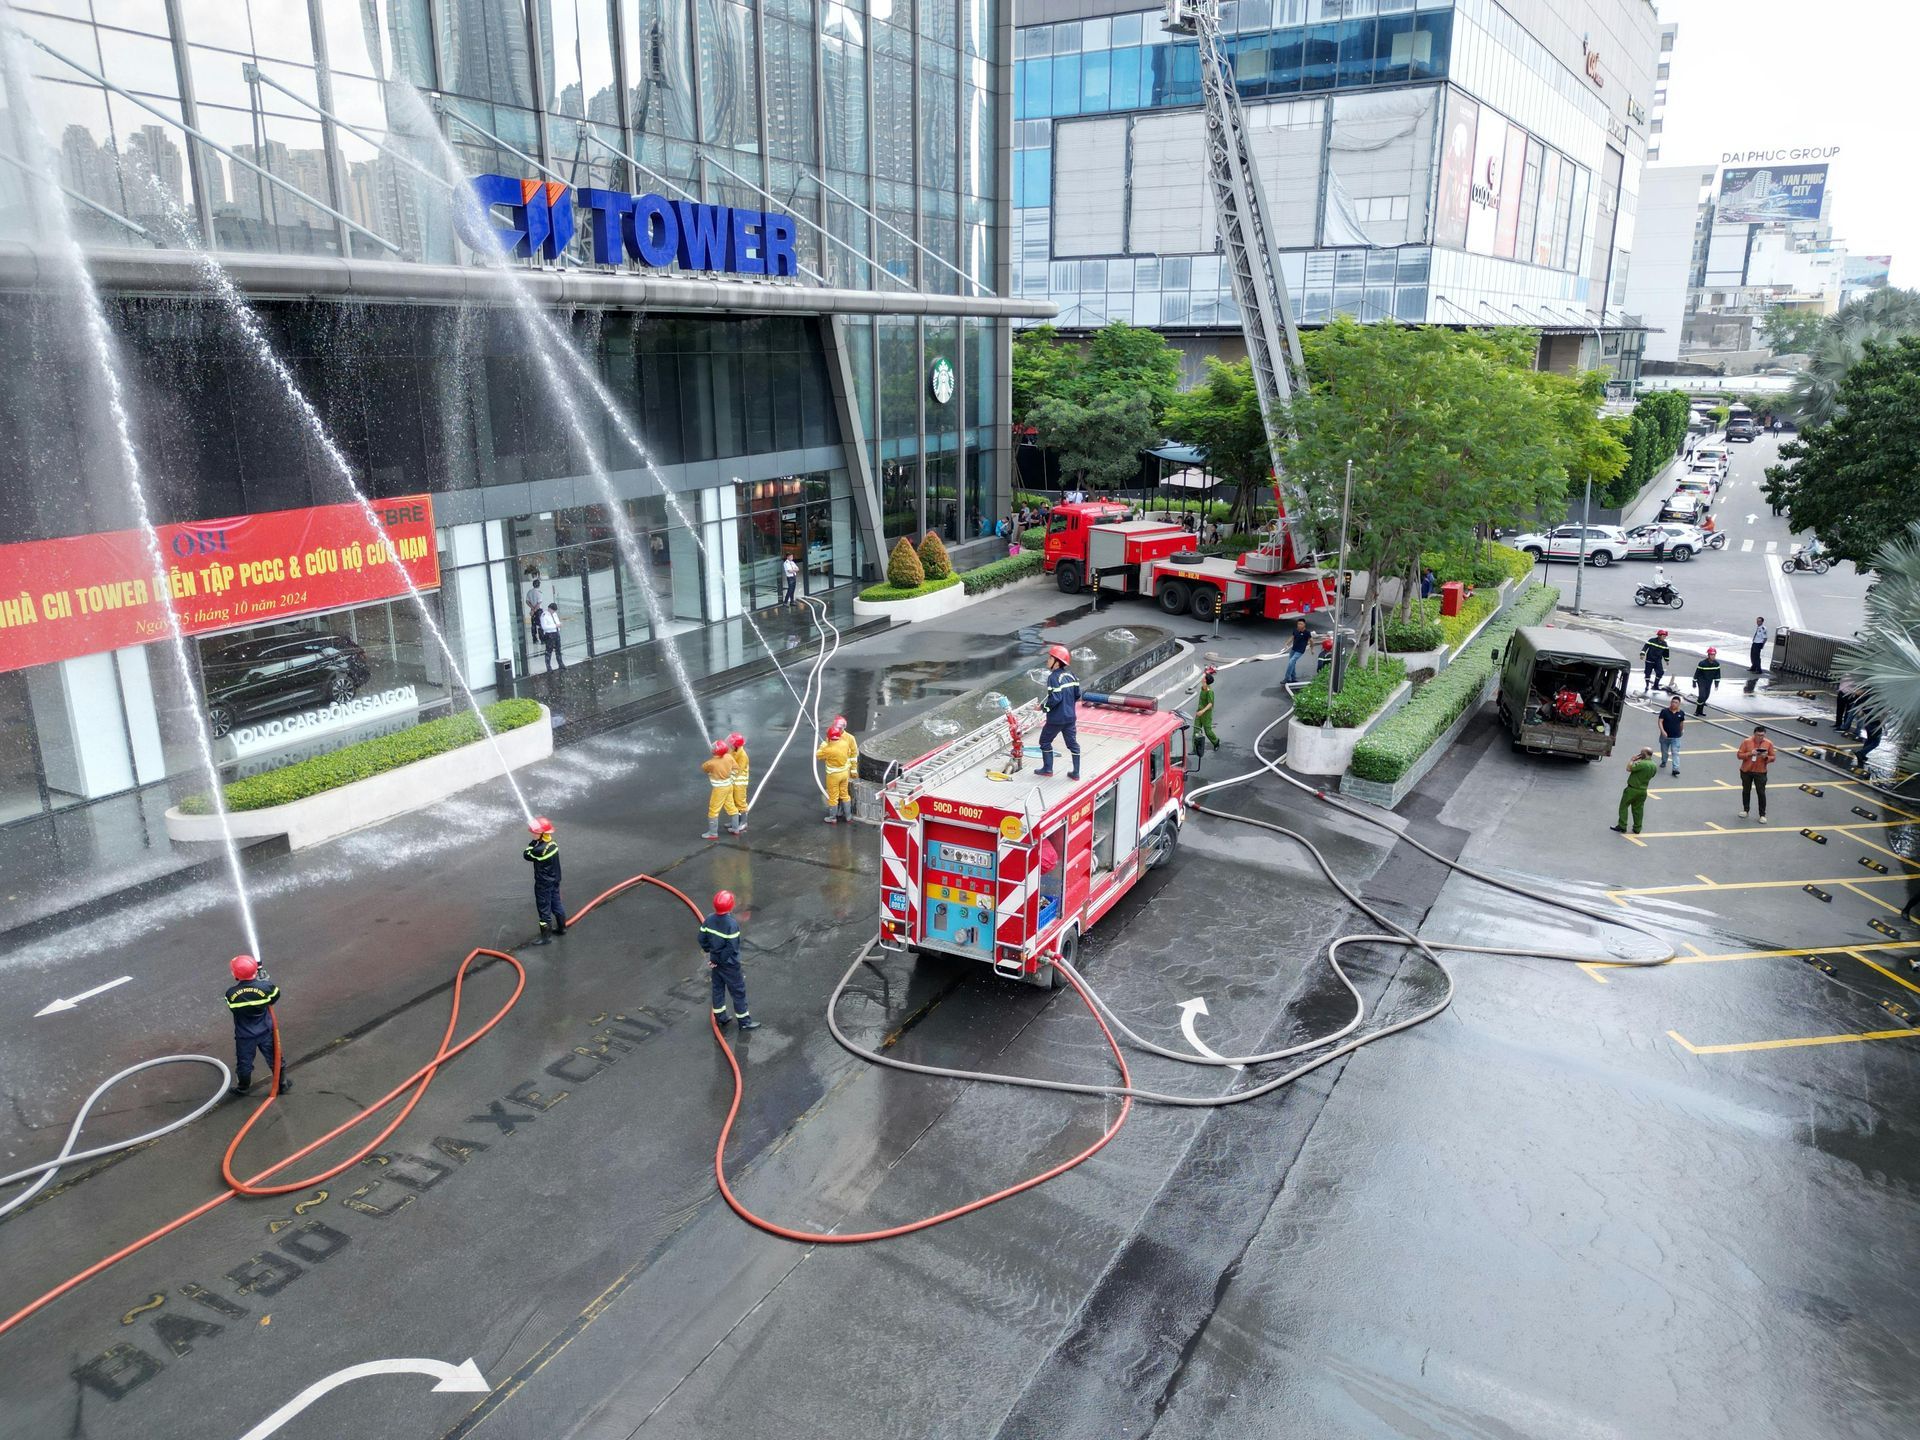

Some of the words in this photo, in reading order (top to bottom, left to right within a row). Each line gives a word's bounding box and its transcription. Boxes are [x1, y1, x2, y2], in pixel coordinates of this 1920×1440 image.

[1722, 152, 1745, 163] DAI
[1747, 150, 1787, 162] PHUC
[1789, 146, 1840, 160] GROUP
[1791, 186, 1812, 197] CITY
[577, 187, 798, 277] TOWER
[172, 530, 228, 558] OBI
[42, 591, 72, 620] CII
[75, 578, 149, 614] TOWER
[200, 562, 234, 597] TẬP
[239, 557, 285, 587] PCCC
[289, 555, 302, 579] &
[305, 547, 338, 576] CỨU
[341, 541, 363, 573] HỘ
[399, 535, 428, 563] NẠN
[195, 608, 229, 622] tháng
[234, 601, 248, 615] 10
[251, 599, 276, 611] năm
[280, 591, 307, 607] 2024
[227, 720, 284, 745] VOLVO
[283, 711, 318, 733] CAR
[361, 684, 417, 711] SAIGON
[933, 801, 953, 814] 50CD
[958, 807, 983, 819] 00097
